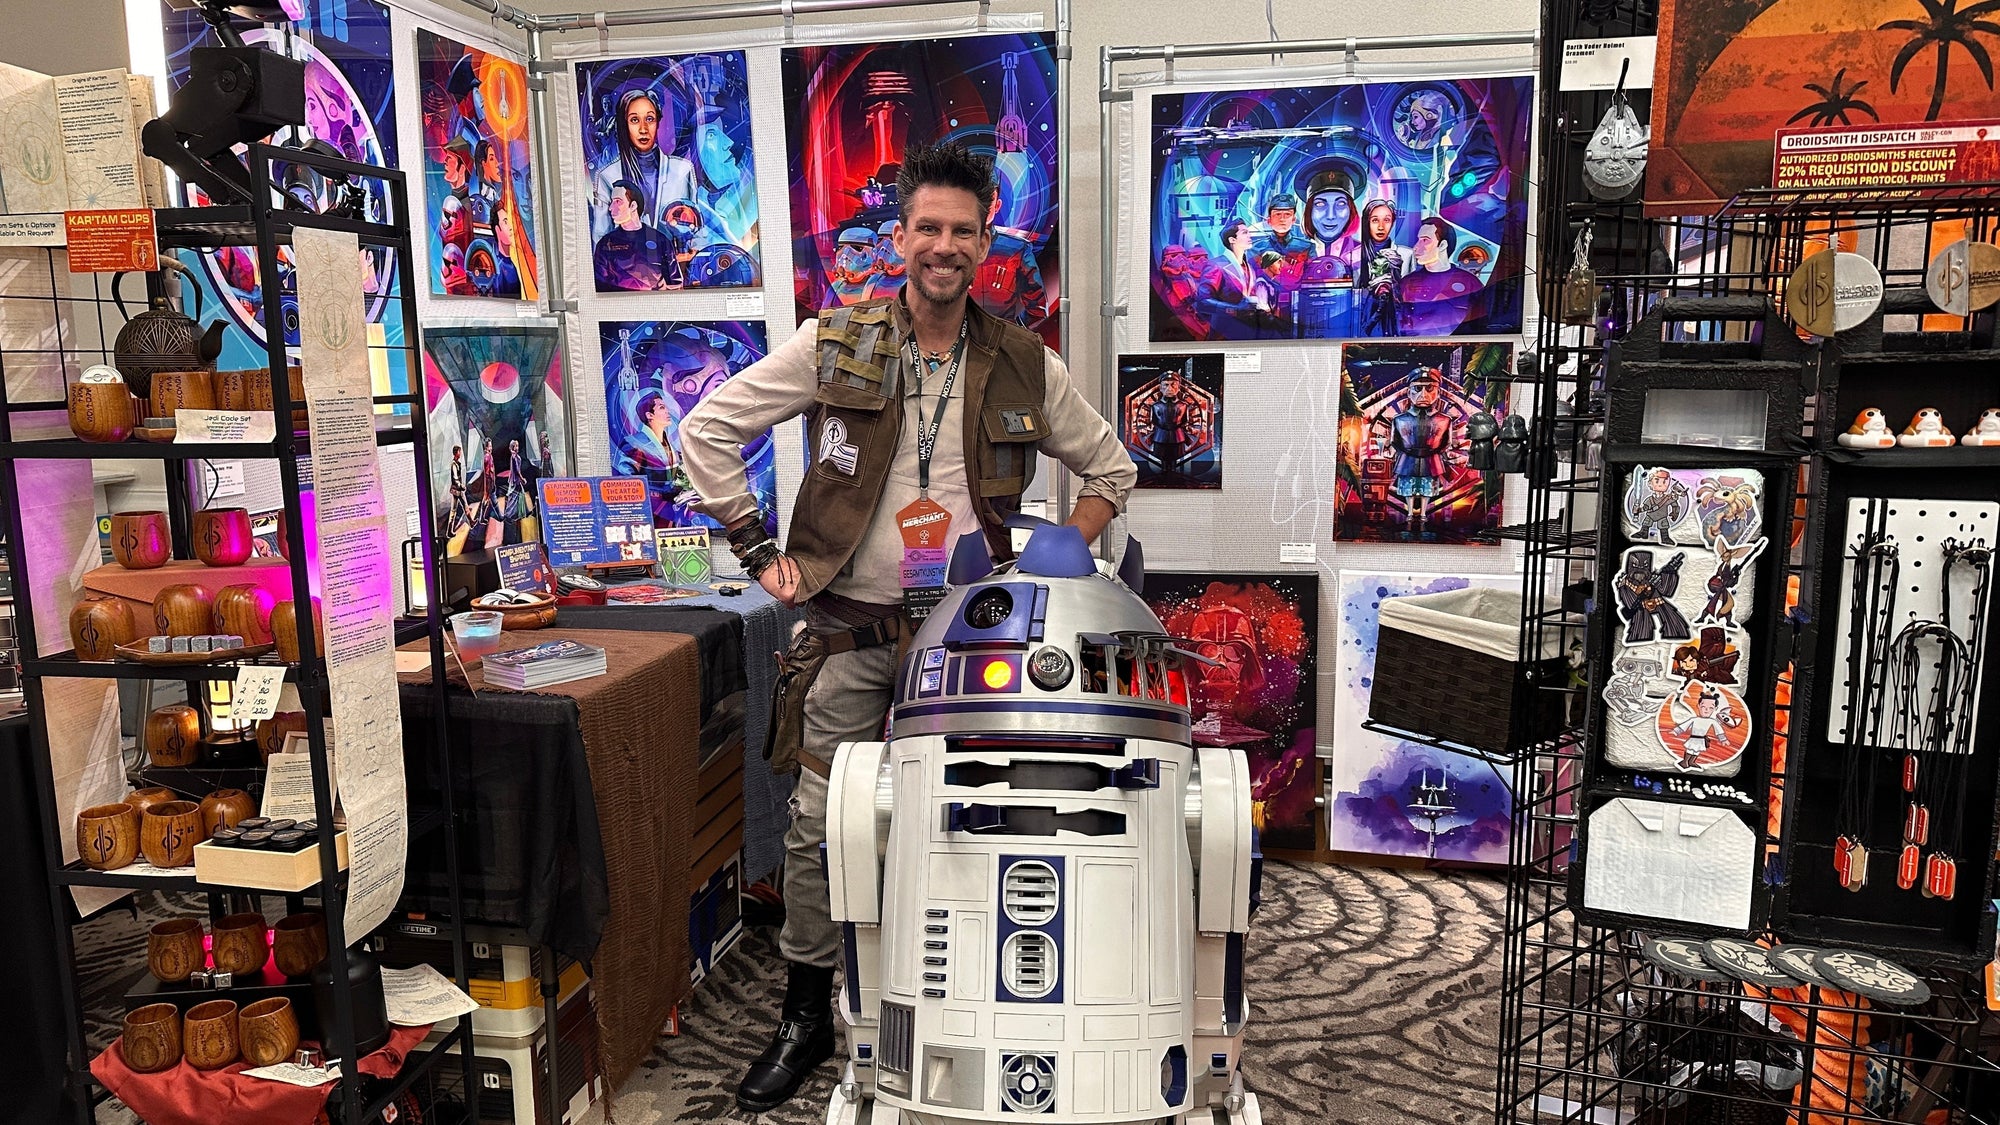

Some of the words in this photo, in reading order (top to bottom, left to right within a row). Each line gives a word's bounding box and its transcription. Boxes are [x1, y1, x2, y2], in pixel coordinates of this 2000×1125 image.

[1787, 134, 1858, 147] DROIDSMITH
[1861, 132, 1916, 143] DISPATCH
[1780, 154, 1838, 164] AUTHORIZED
[1841, 150, 1906, 162] DROIDSMITHS
[1908, 149, 1948, 159] RECEIVE
[1949, 148, 1956, 158] A
[1780, 166, 1806, 177] 20%
[1809, 162, 1888, 178] REQUISITION
[1891, 160, 1956, 172] DISCOUNT
[1778, 180, 1791, 188] ON
[1793, 179, 1810, 187] ALL
[1812, 177, 1858, 186] VACATION
[1860, 175, 1909, 184] PROTOCOL
[1911, 174, 1946, 183] PRINTS
[69, 214, 118, 225] KAR'TAM
[120, 214, 150, 223] CUPS
[910, 341, 920, 378] HALCY-CON
[941, 362, 958, 399] HALCY-CON
[902, 512, 945, 528] MERCHANT
[500, 544, 536, 558] COMPLIMENTARY
[510, 552, 530, 563] SHIPPING
